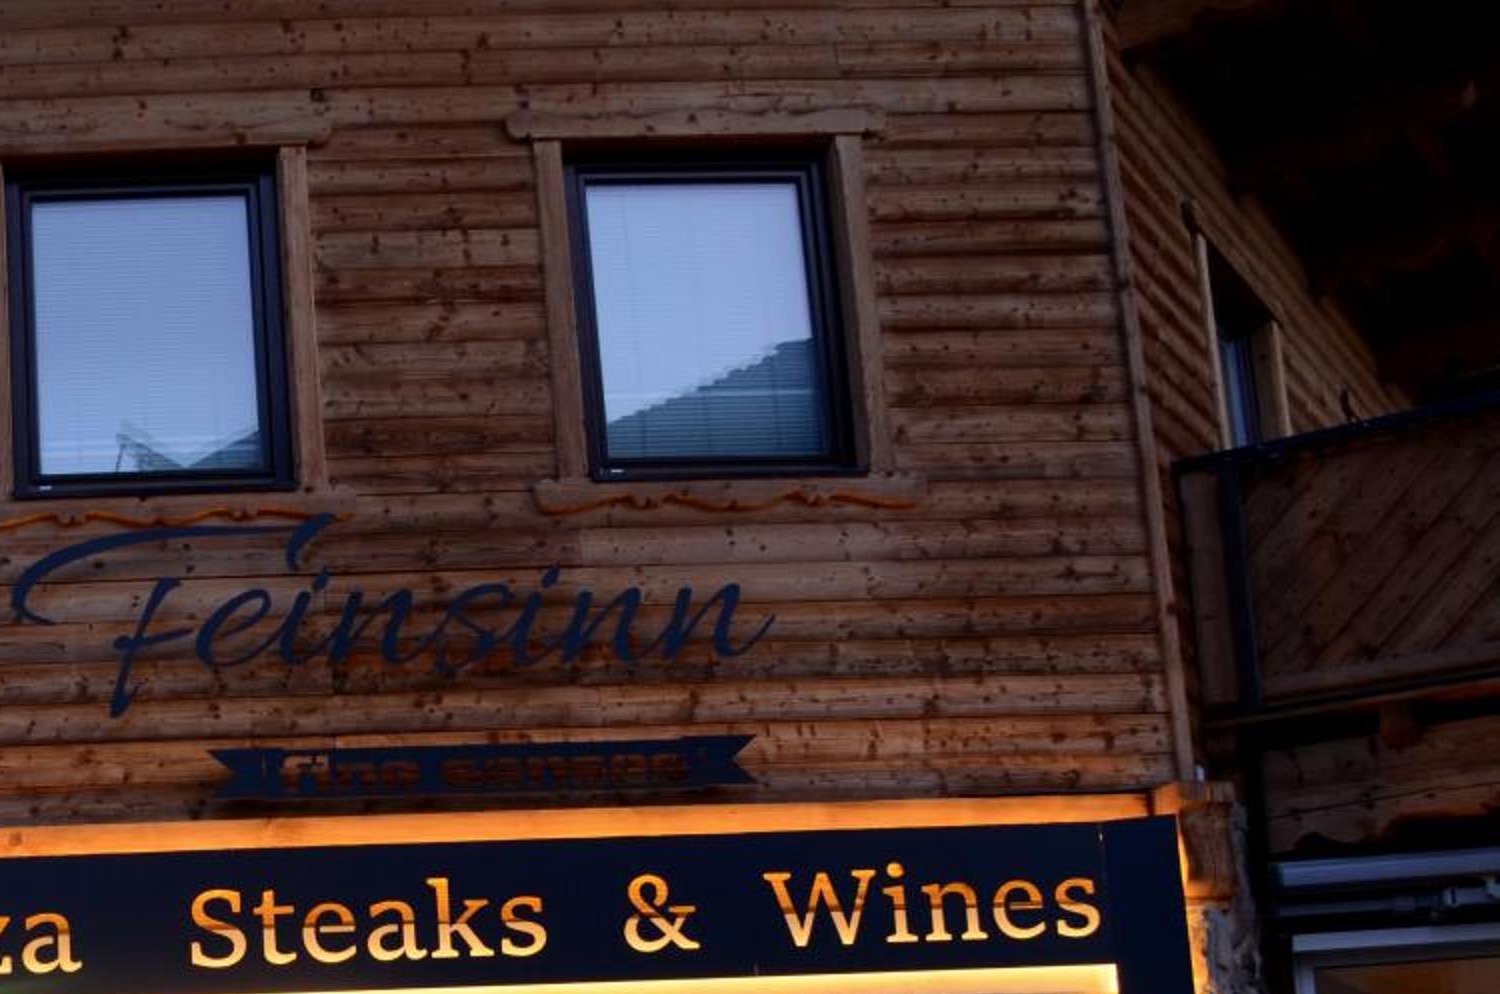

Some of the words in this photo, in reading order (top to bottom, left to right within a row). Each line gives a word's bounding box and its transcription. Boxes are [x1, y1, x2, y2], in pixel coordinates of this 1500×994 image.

[11, 511, 776, 719] Feinsinn
[280, 754, 419, 793] fine
[443, 752, 688, 788] senses
[189, 876, 549, 970] Steaks
[622, 873, 701, 954] &
[762, 861, 1102, 947] Wines
